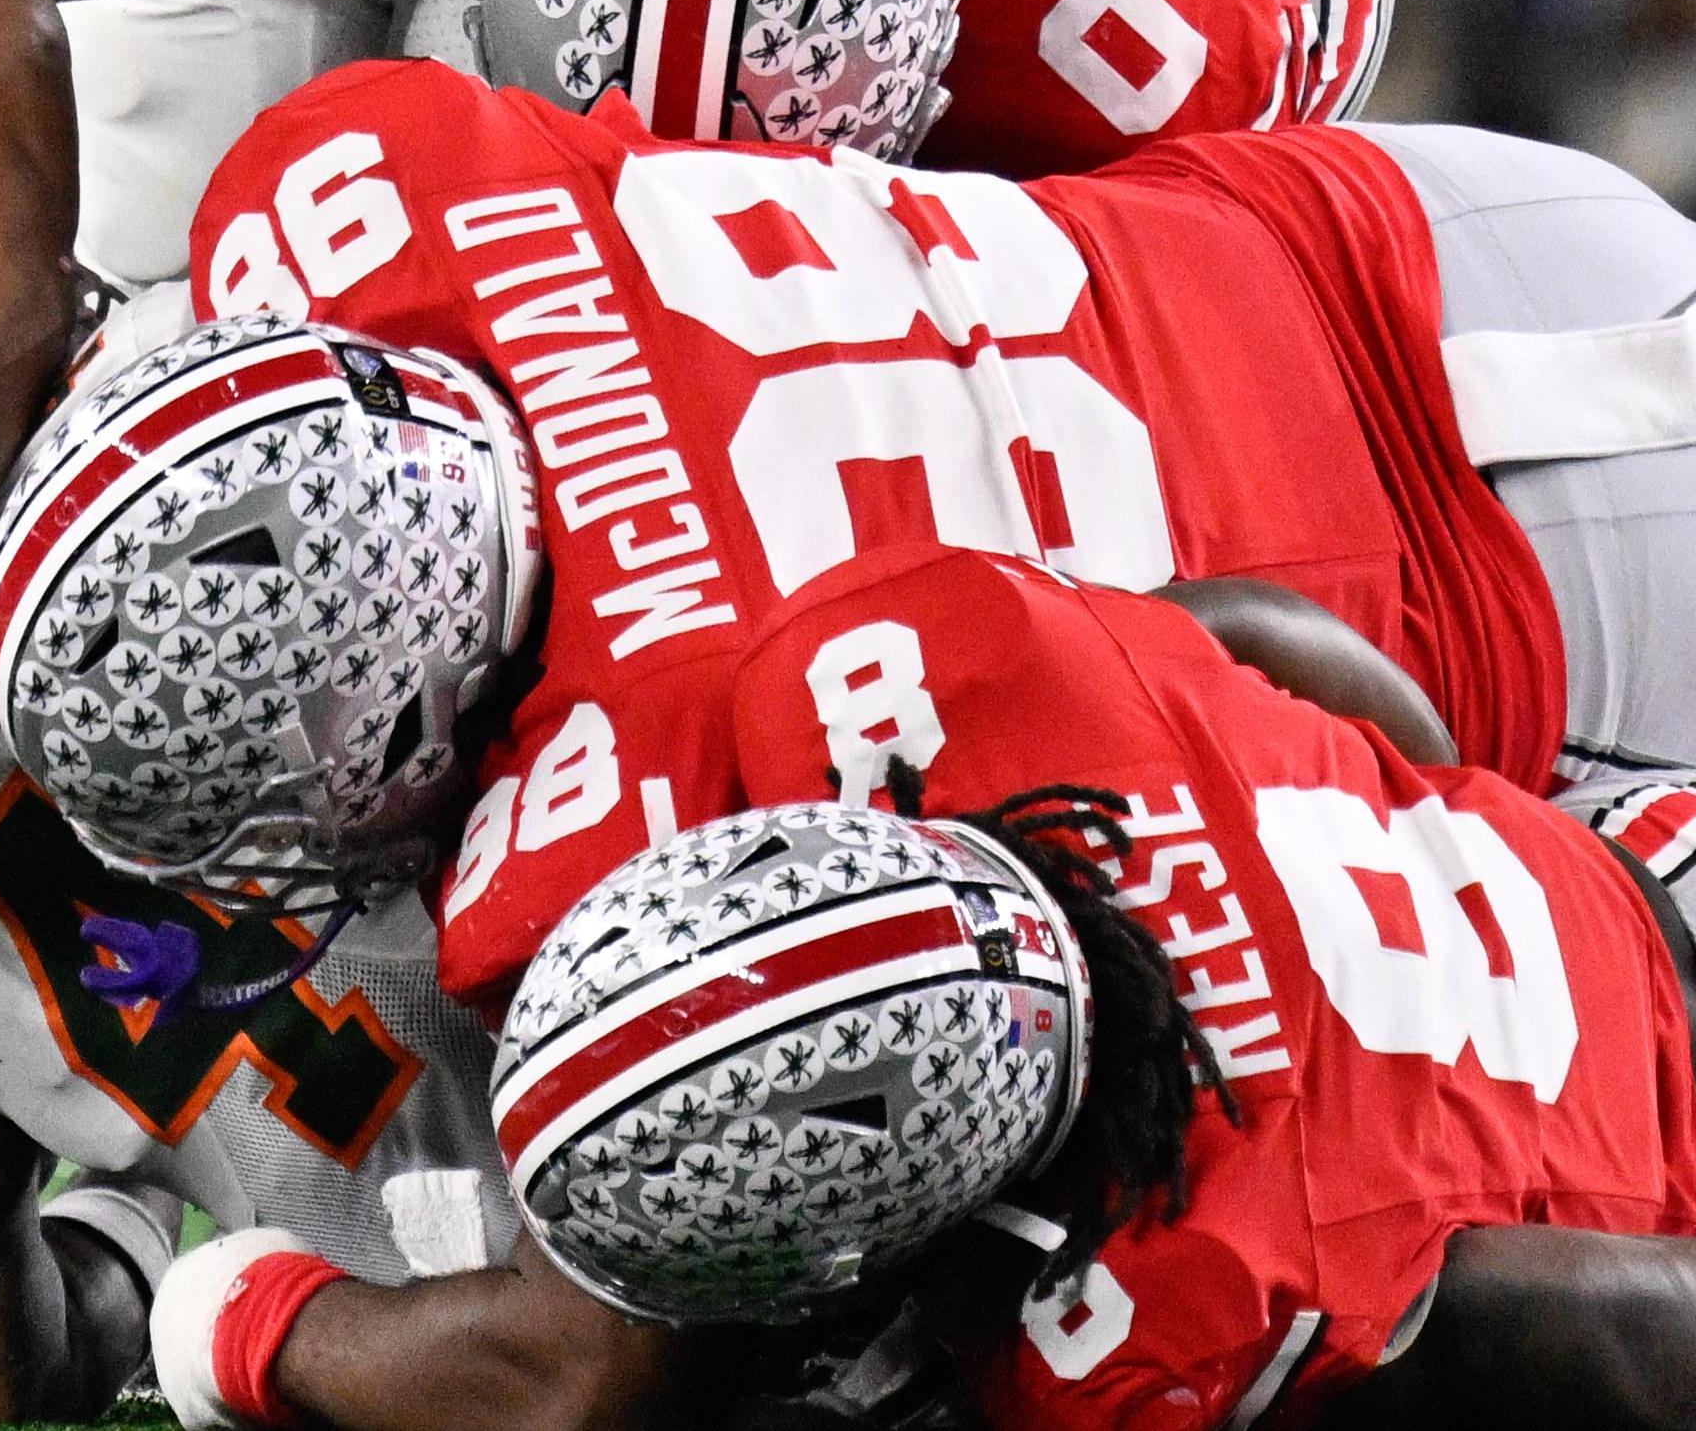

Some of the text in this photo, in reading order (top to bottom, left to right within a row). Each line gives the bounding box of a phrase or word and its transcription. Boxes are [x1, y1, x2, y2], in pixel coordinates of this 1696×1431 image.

[806, 620, 946, 789] 8
[1074, 783, 1293, 1085] REESE
[1255, 785, 1580, 1106] 8
